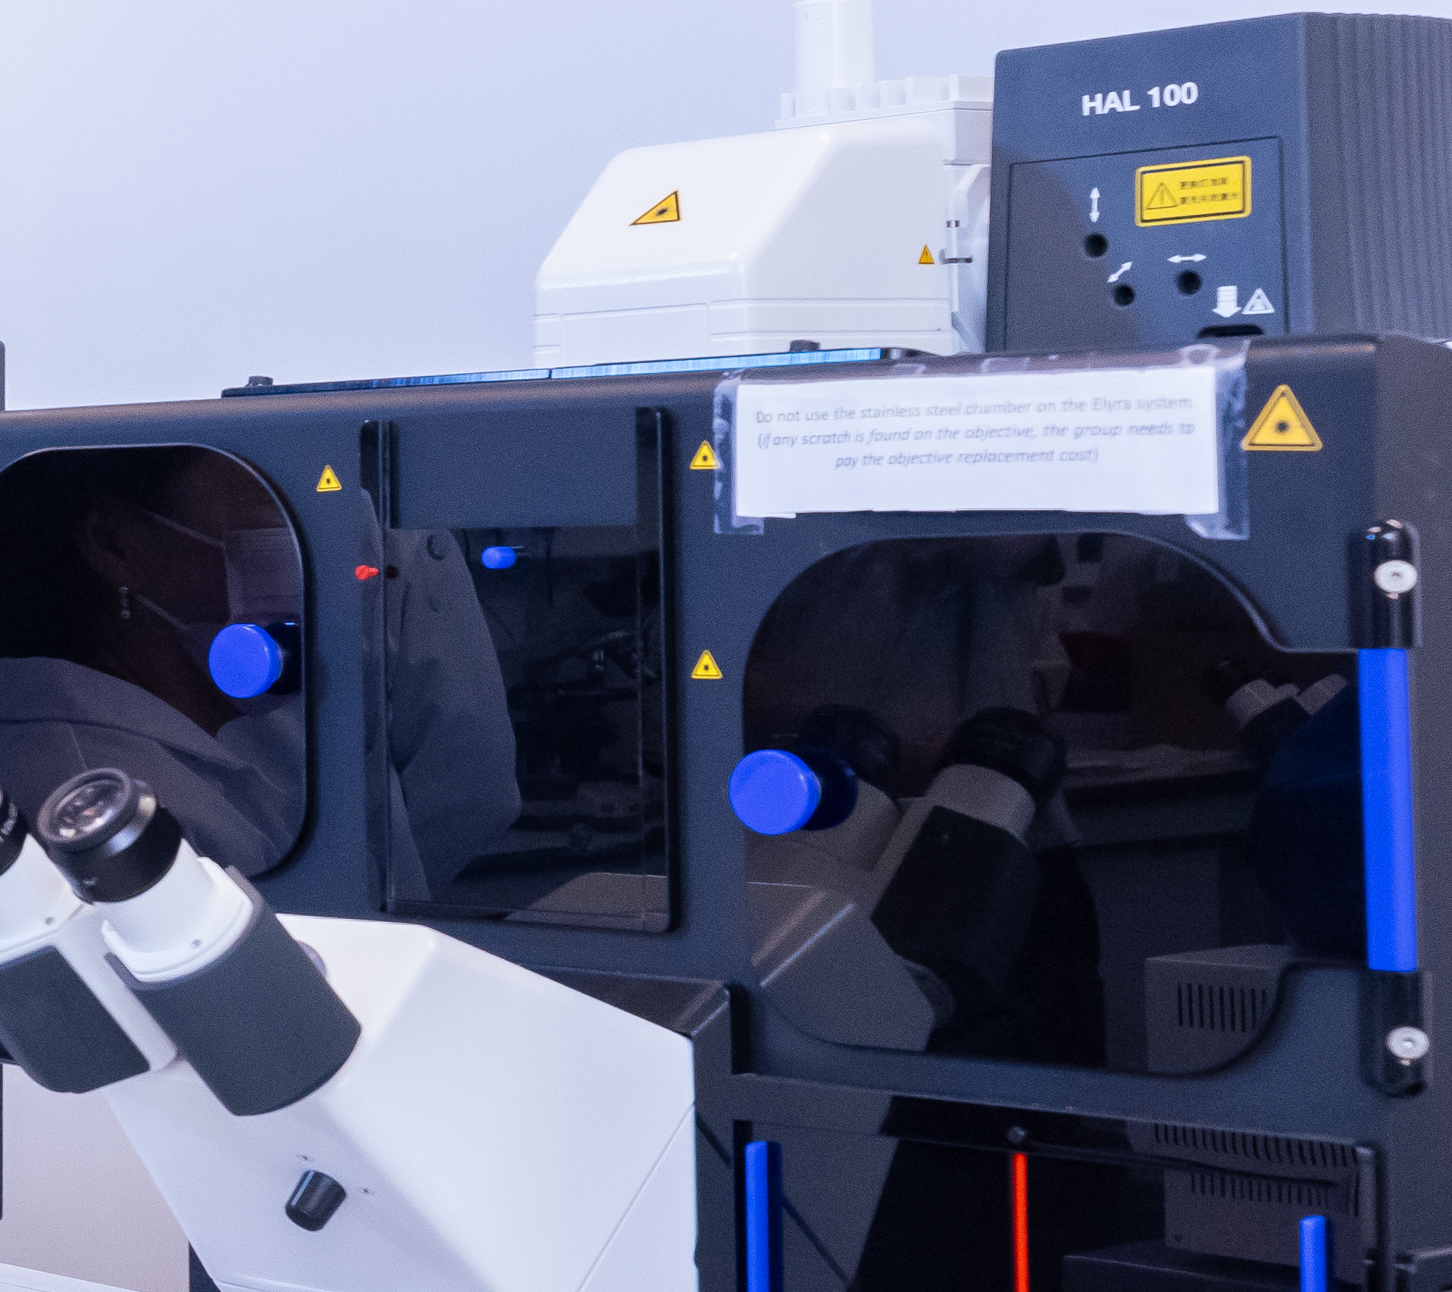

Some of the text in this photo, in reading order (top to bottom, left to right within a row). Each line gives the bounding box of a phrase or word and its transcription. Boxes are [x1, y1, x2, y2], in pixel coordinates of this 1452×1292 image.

[1081, 81, 1199, 116] HAL 100
[756, 410, 773, 424] Do
[778, 409, 800, 423] not
[806, 410, 829, 422] use
[835, 407, 856, 420] the
[860, 404, 921, 419] stainless
[926, 401, 961, 417] steel
[964, 399, 1031, 416] chamber
[1037, 401, 1057, 414] on
[1061, 397, 1088, 413] the
[772, 435, 798, 449] any
[801, 430, 851, 446] scratch
[855, 430, 865, 443] is
[868, 426, 911, 445] found
[914, 429, 932, 441] on
[937, 426, 959, 440] the
[1042, 422, 1067, 438] the
[1072, 424, 1124, 440] group
[1128, 420, 1174, 436] needs
[1179, 421, 1197, 435] to
[835, 455, 858, 470] pay
[862, 451, 883, 466] the
[888, 450, 953, 469] objective
[957, 449, 1055, 465] replacement
